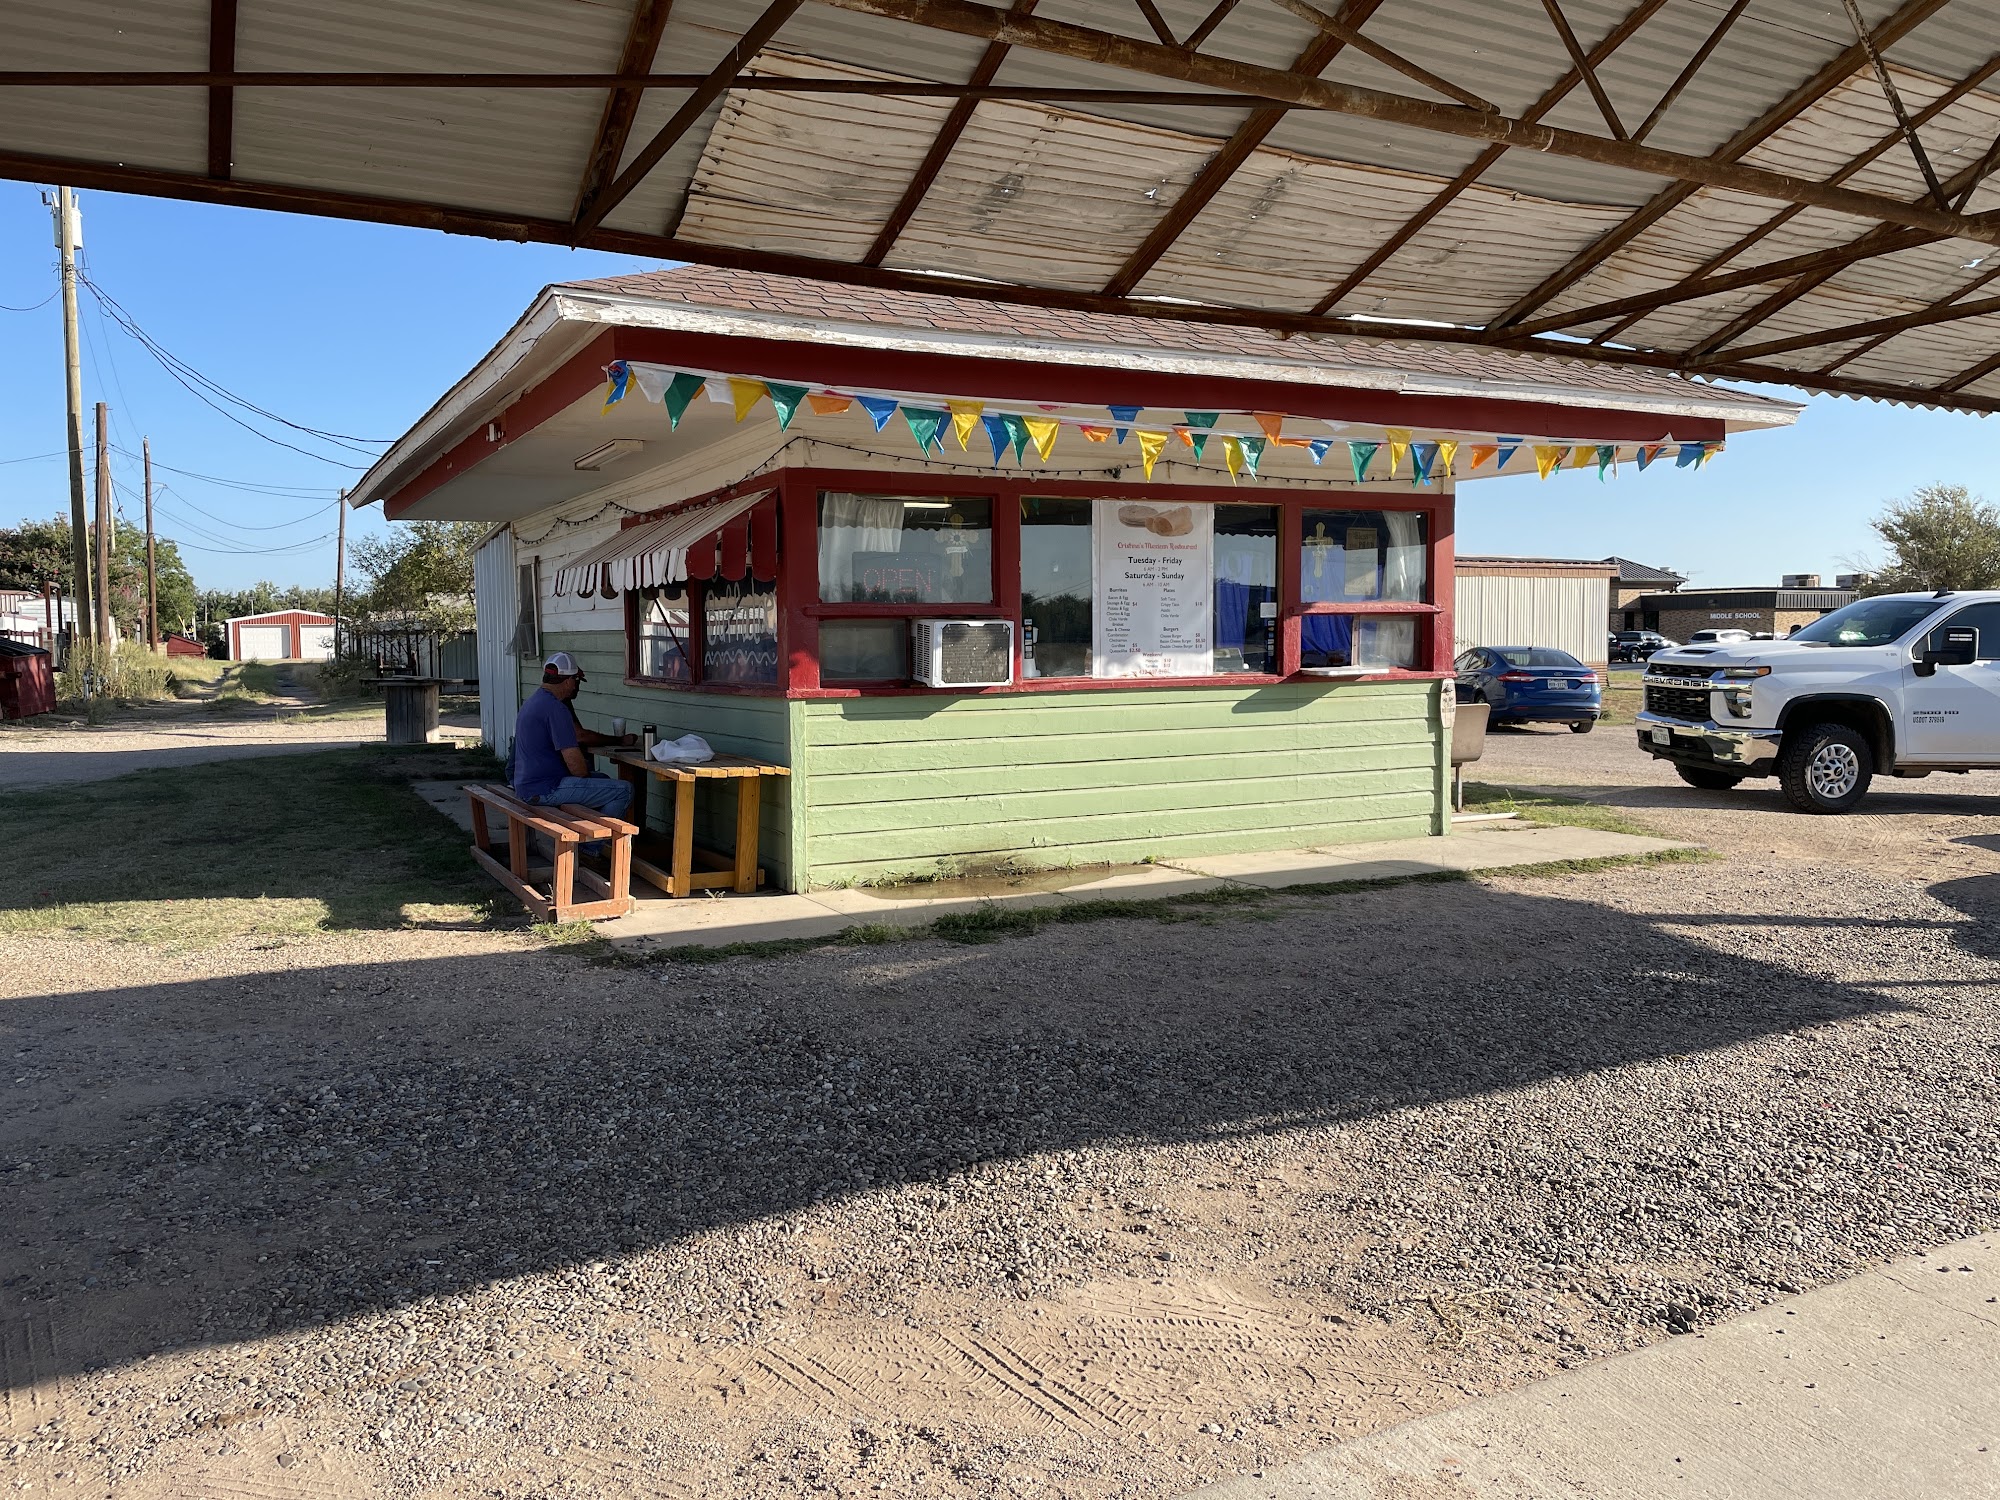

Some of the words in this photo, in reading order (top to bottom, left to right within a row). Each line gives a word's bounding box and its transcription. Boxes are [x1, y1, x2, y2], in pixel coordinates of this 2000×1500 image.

[1128, 556, 1156, 565] Tuesday
[1162, 557, 1182, 565] Friday
[864, 569, 931, 592] OPEN
[1125, 572, 1155, 580] Saturday
[1162, 572, 1184, 580] Sunday
